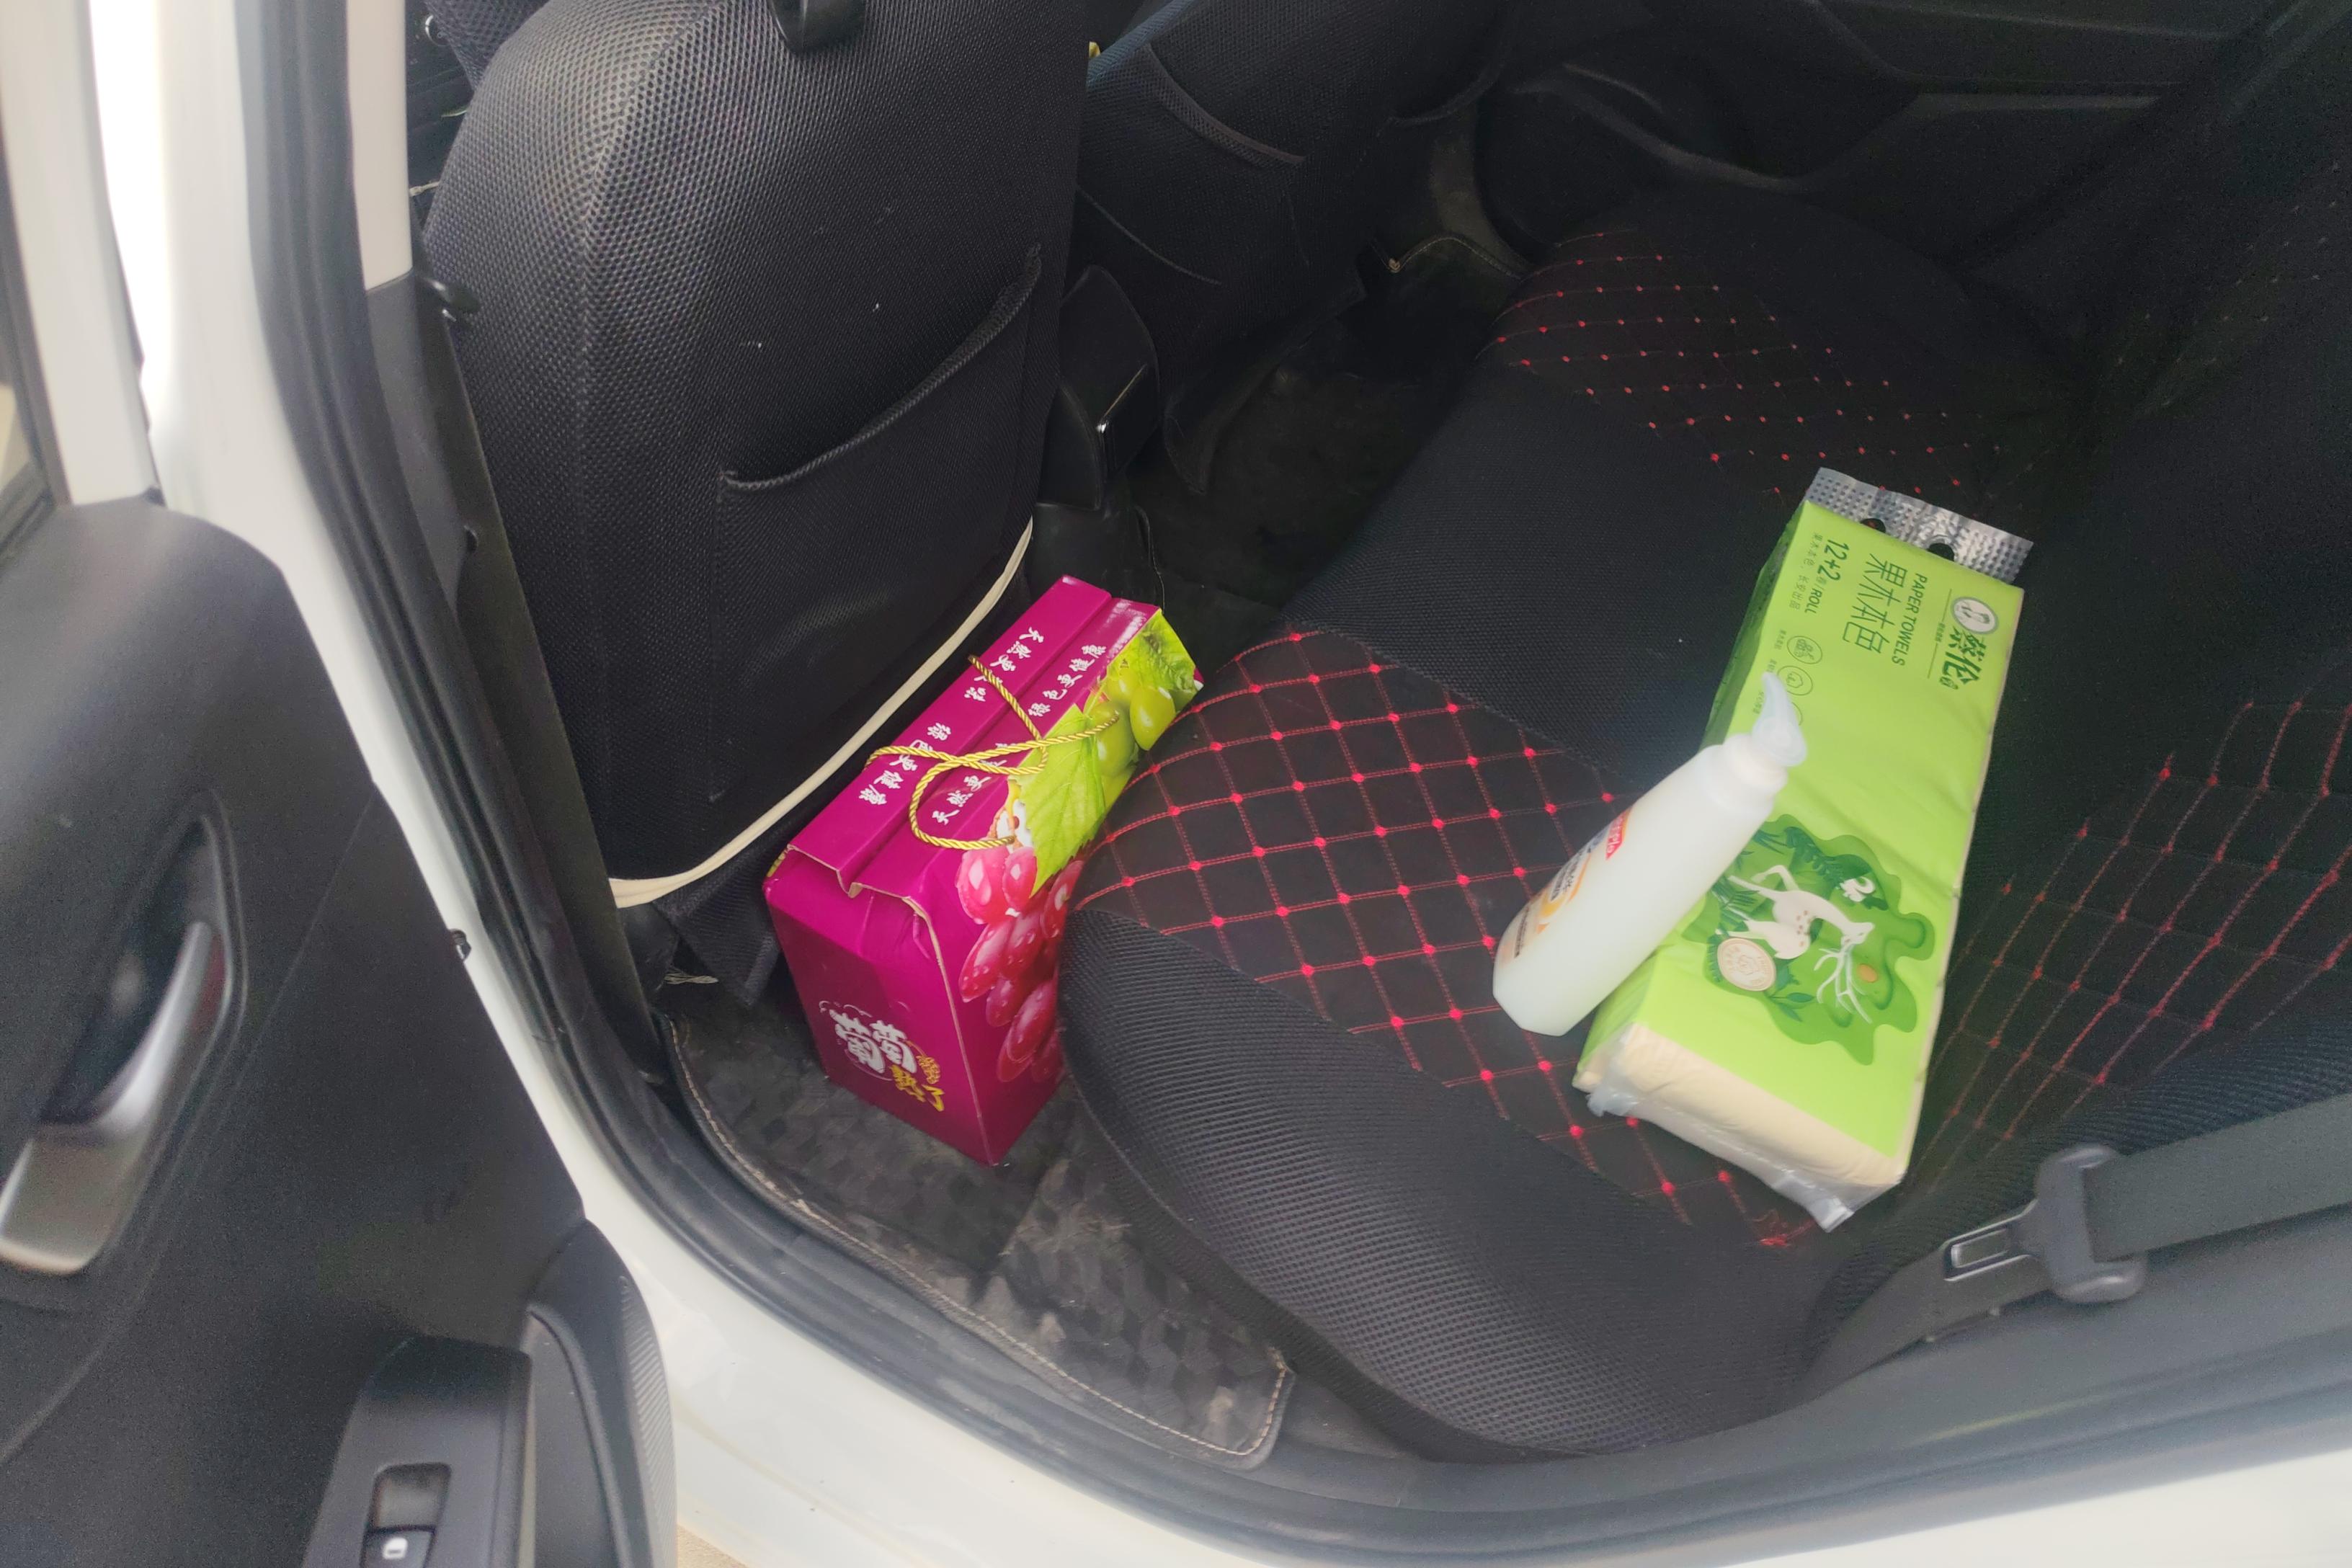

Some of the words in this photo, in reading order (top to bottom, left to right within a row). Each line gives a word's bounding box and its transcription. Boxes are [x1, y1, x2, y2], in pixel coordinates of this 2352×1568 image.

[1817, 538, 1850, 582] 12+2
[1842, 552, 1910, 655] 果木本色
[1905, 572, 1928, 615] PAPER
[1891, 614, 1917, 667] TOWELS
[1942, 625, 1987, 685] 蔡伦
[931, 742, 1018, 826] 天然更
[1028, 644, 1107, 717] 绿色更健康
[829, 1009, 917, 1074] 葡萄
